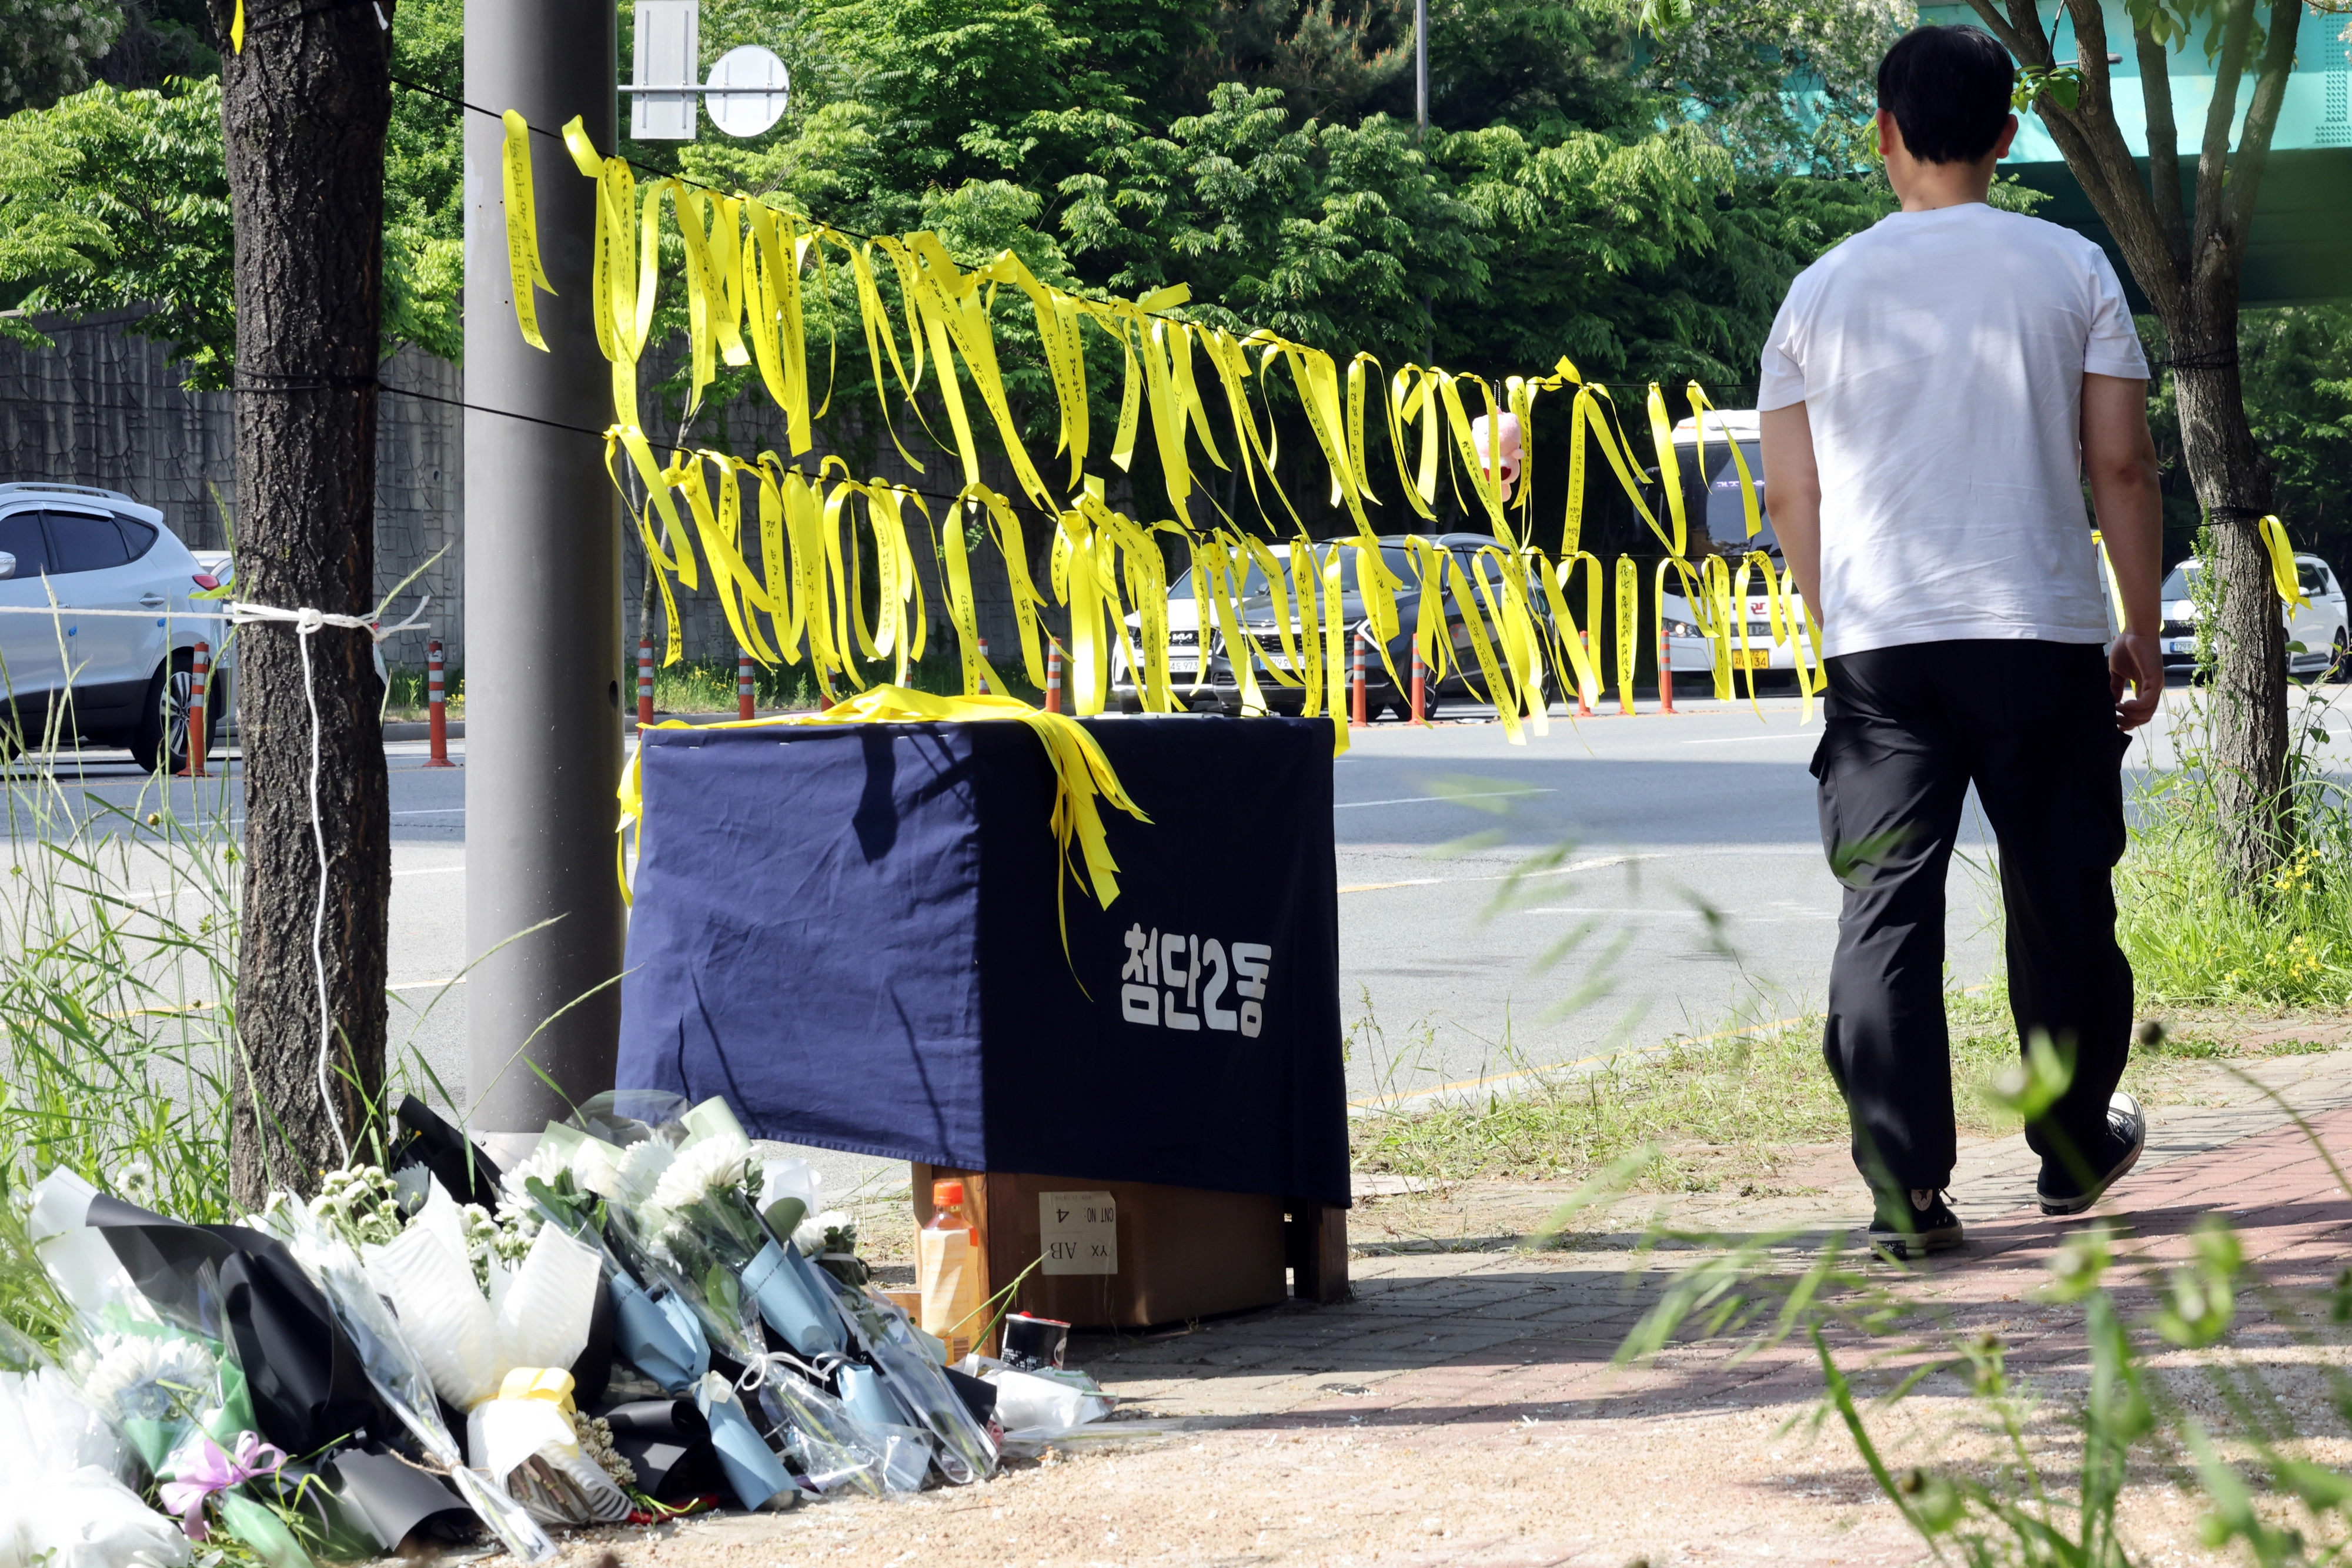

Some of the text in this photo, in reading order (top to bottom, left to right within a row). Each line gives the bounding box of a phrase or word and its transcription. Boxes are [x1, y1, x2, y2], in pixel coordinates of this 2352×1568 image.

[1047, 332, 1057, 352] 삼가
[1470, 619, 1514, 728] 삼가 고인의 명복을 빕니다
[1121, 922, 1272, 1039] 첨단2동
[1056, 1207, 1114, 1223] CNT NO: 4
[1050, 1242, 1108, 1260] YX AB
